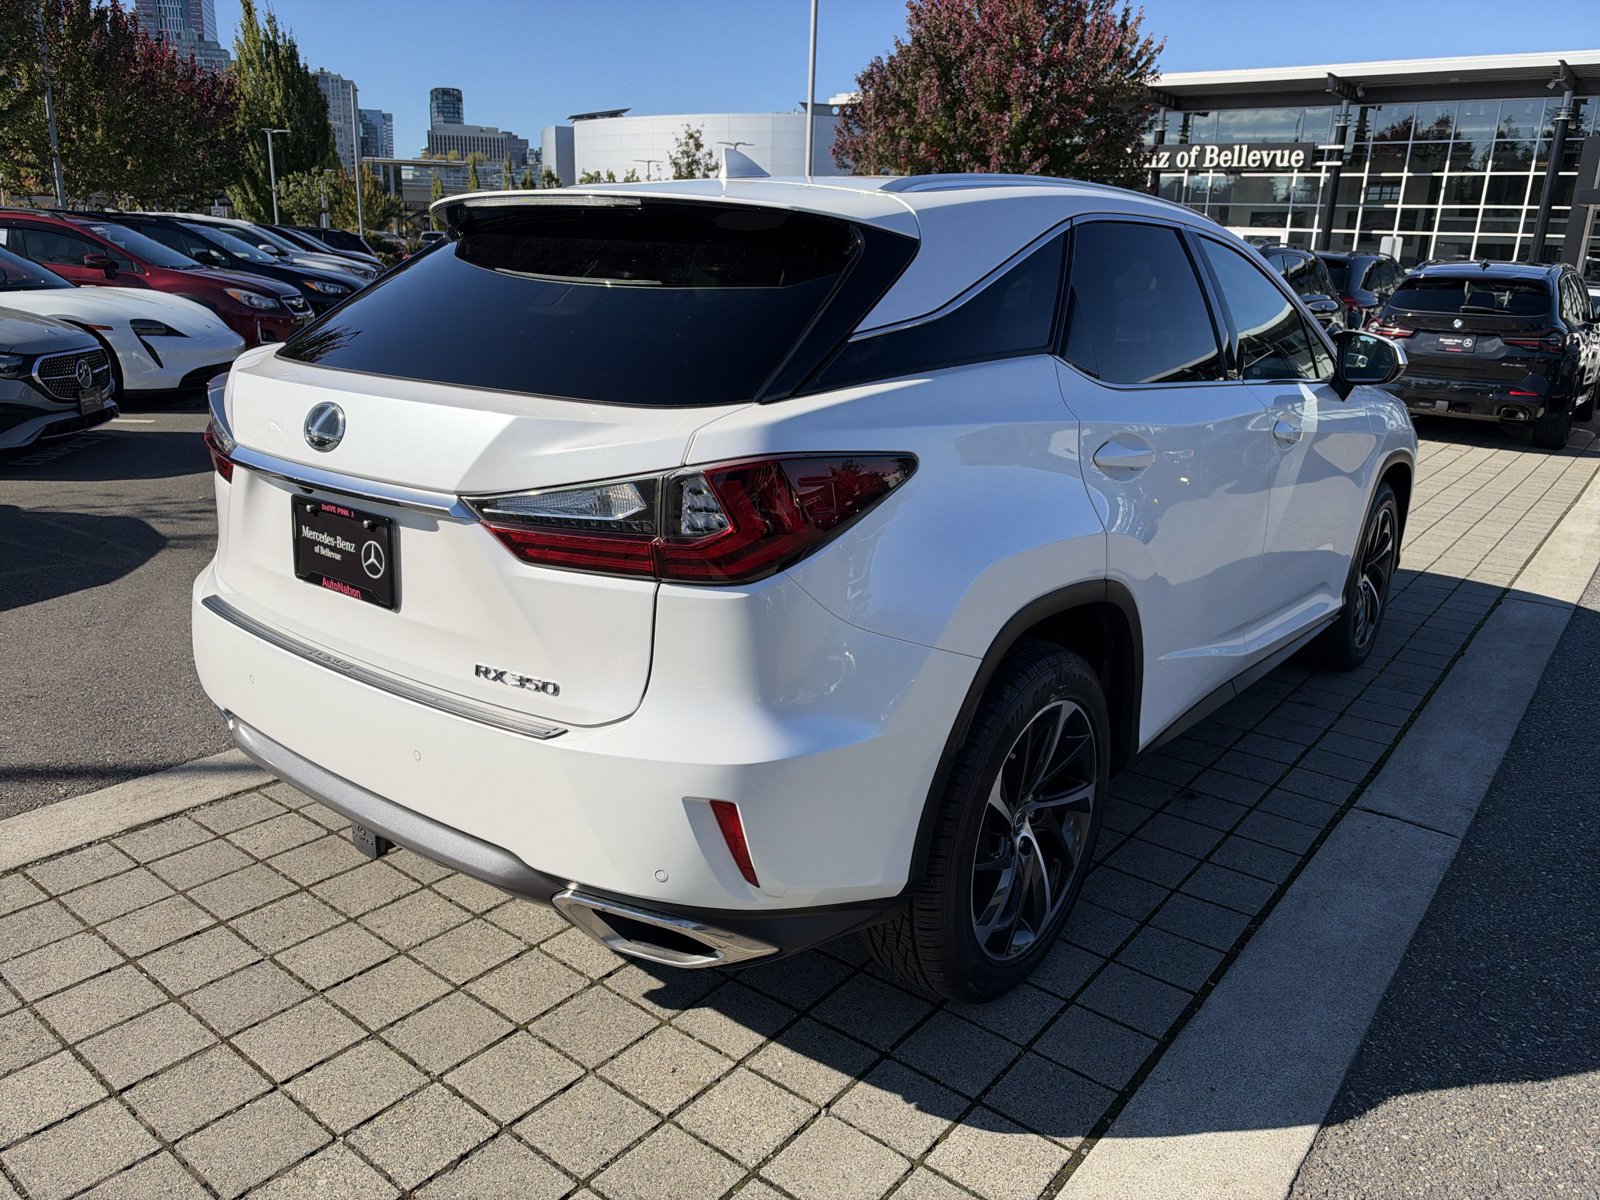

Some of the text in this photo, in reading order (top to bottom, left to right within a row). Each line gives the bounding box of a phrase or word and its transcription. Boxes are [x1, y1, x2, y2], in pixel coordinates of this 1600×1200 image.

[1176, 145, 1201, 168] of
[1202, 144, 1304, 168] Bellevue
[301, 524, 356, 553] Mercedes-Benz
[313, 544, 342, 561] of Bellevue
[322, 576, 362, 599] AutoNation
[474, 663, 561, 697] RX 350
